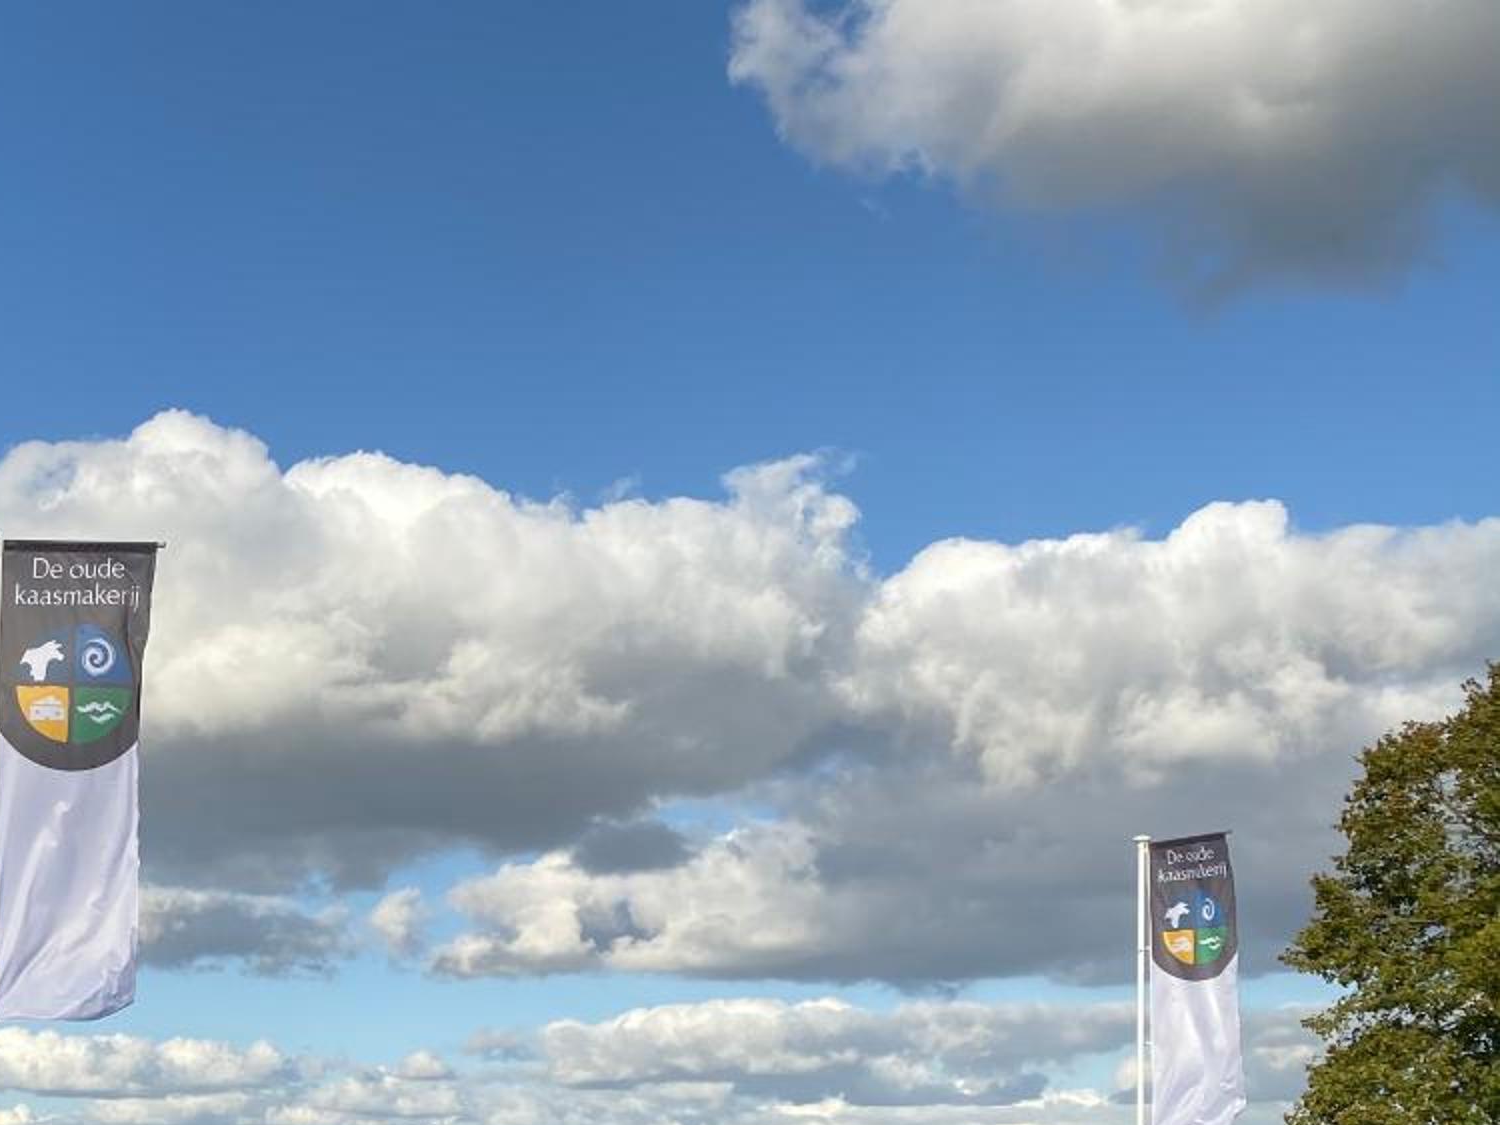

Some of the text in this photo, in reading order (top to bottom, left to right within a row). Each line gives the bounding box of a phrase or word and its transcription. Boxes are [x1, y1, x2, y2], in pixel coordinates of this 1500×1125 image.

[32, 557, 125, 580] De oude
[14, 584, 141, 612] kaasmakerij
[1166, 849, 1183, 865] De
